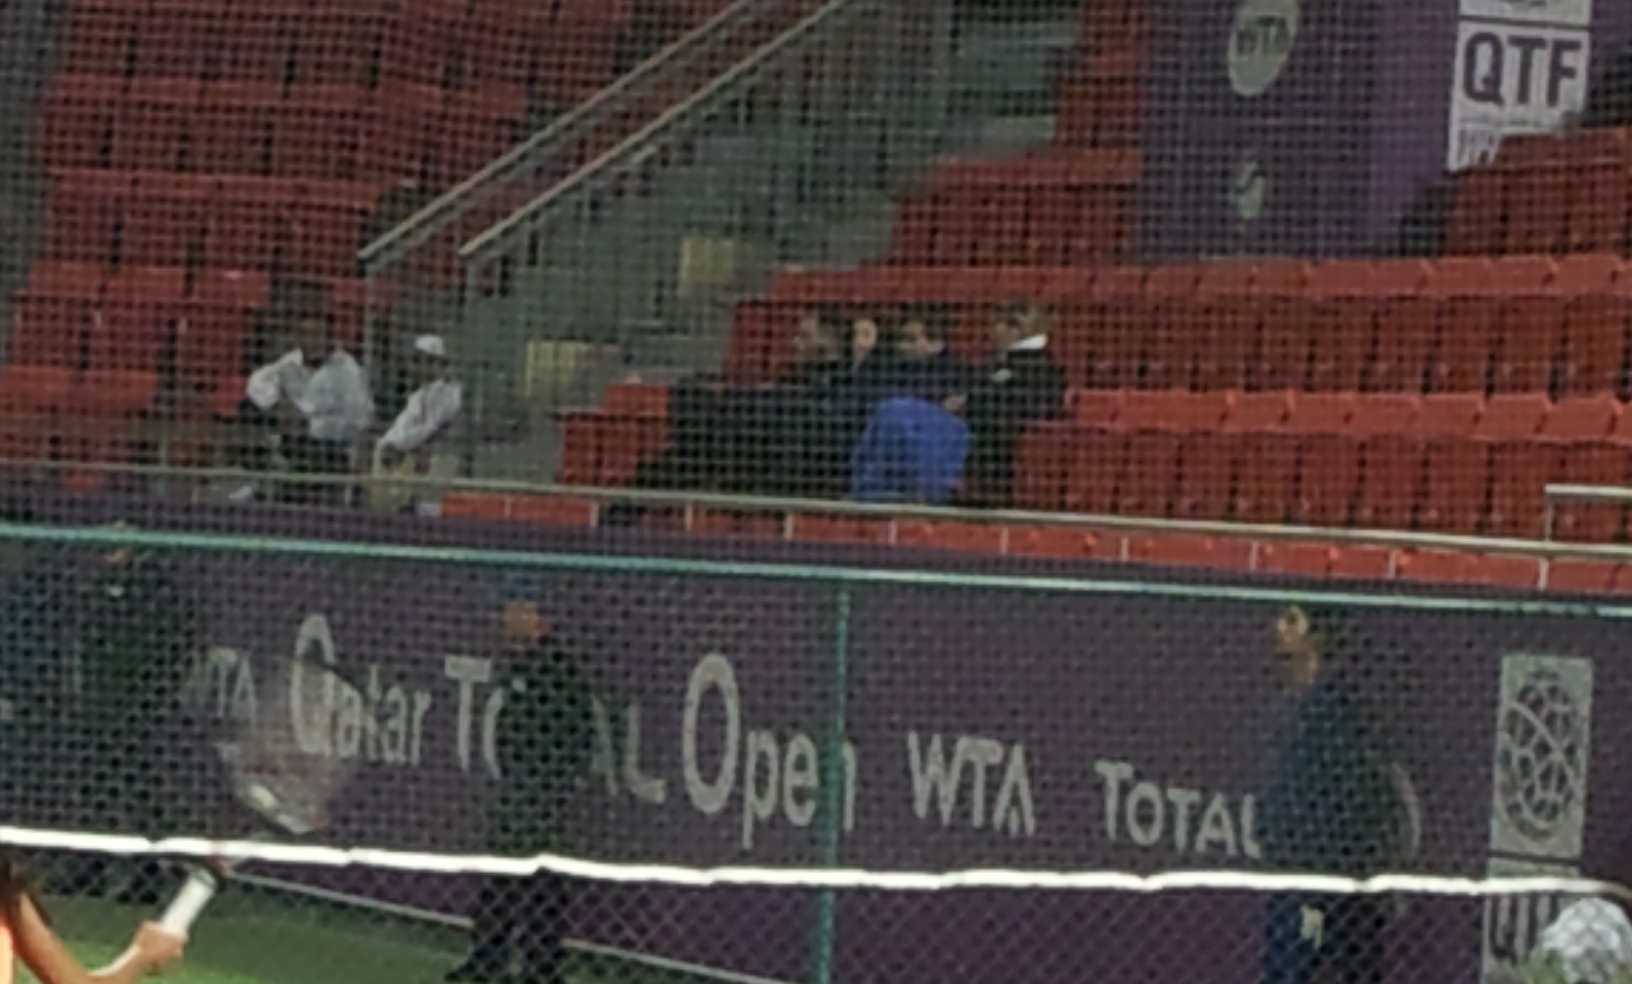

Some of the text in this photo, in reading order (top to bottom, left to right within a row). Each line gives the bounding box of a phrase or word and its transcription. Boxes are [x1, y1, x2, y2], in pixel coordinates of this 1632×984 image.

[1464, 31, 1582, 108] QTF
[682, 653, 857, 849] Open
[907, 730, 1035, 837] WTA
[1094, 760, 1261, 859] TOTAL
